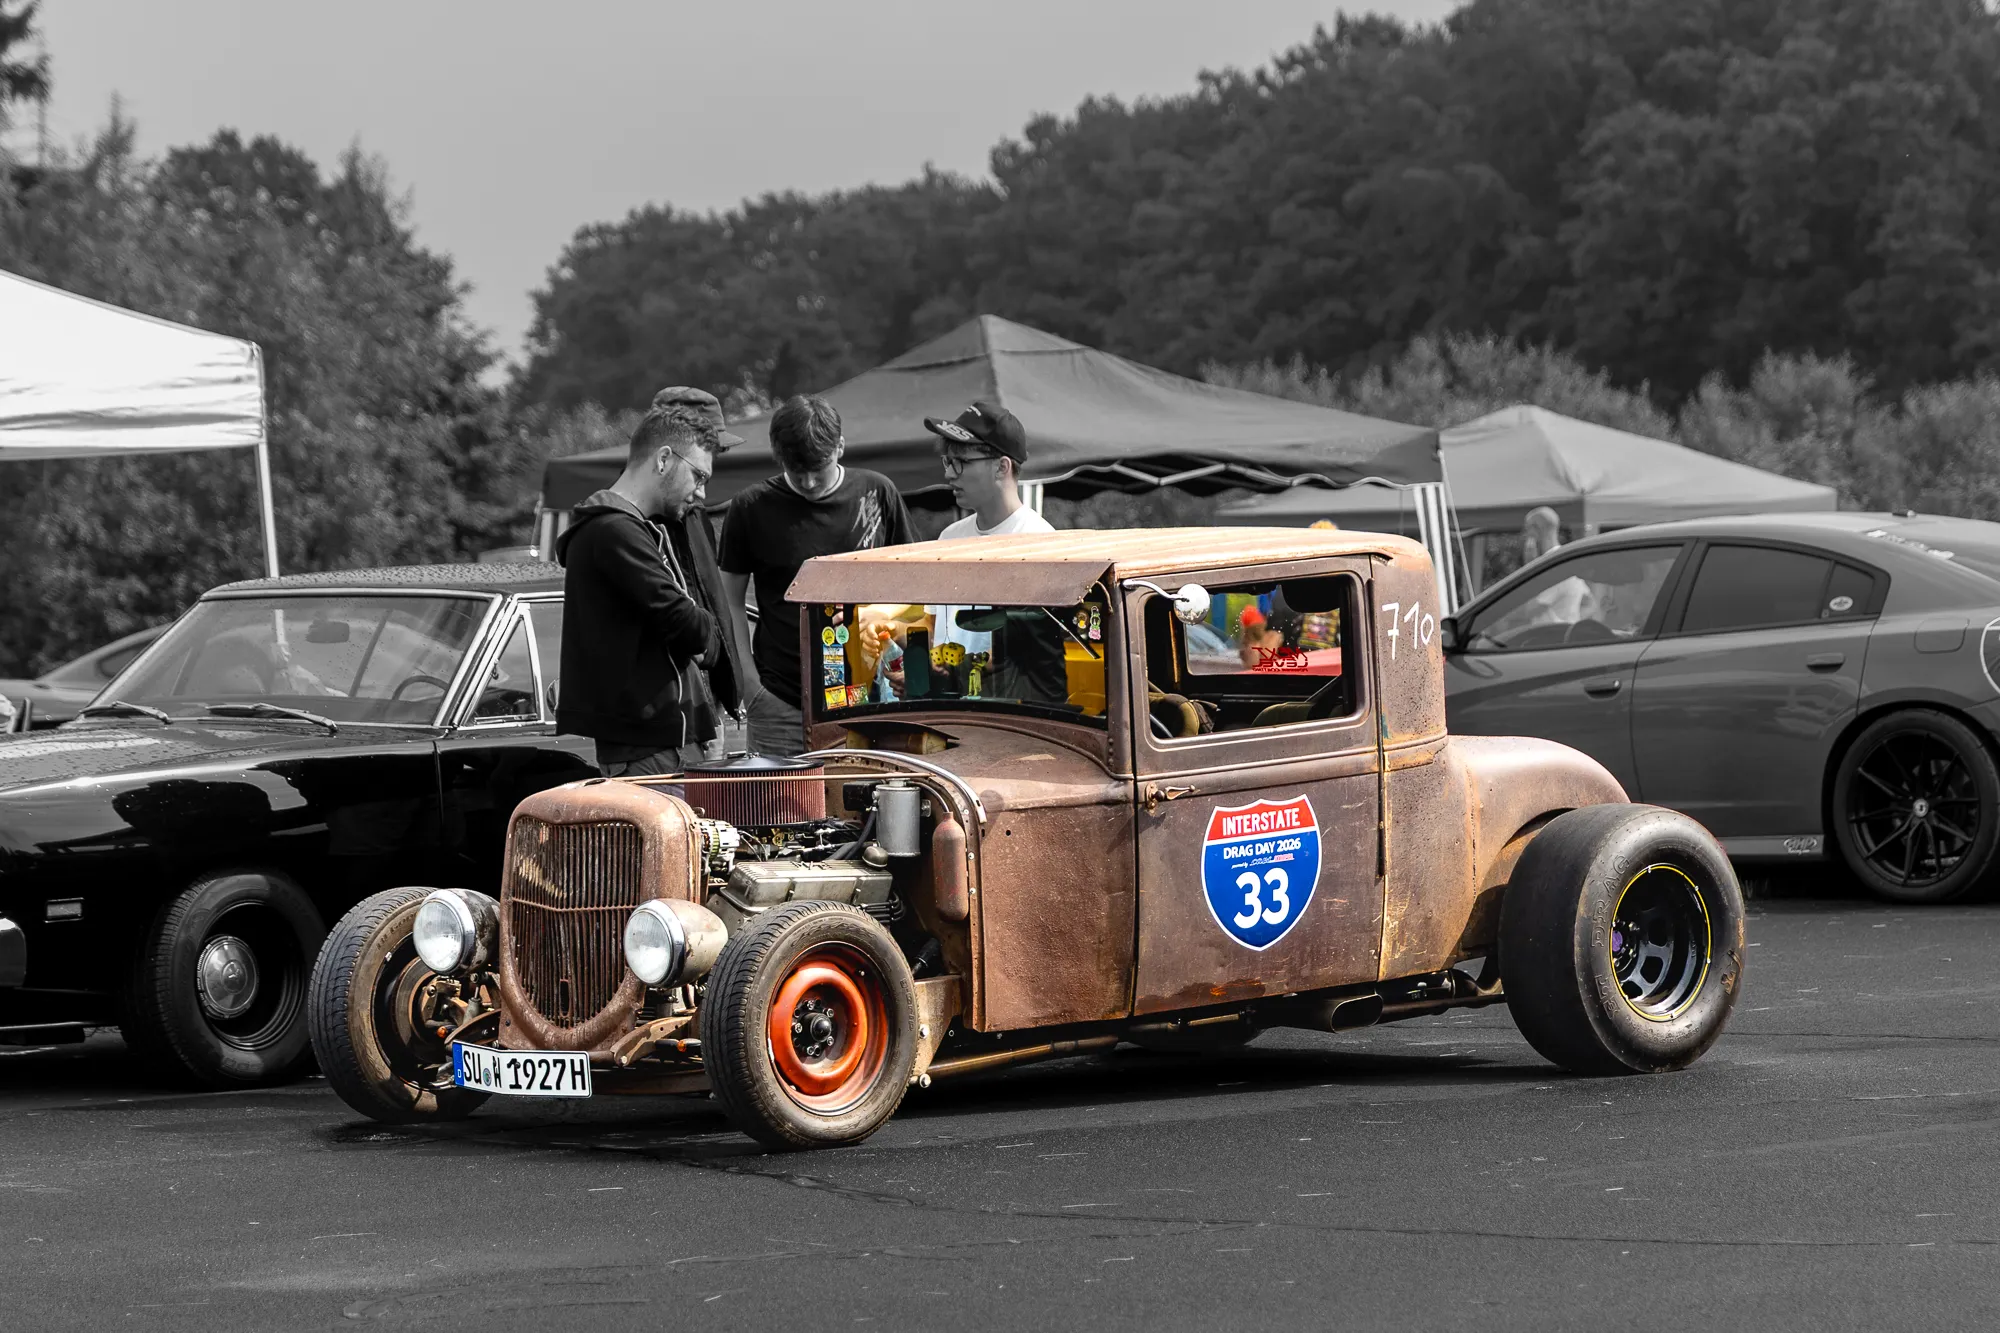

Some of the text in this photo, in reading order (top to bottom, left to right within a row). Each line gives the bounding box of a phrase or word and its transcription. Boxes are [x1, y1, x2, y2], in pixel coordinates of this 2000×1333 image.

[1382, 601, 1435, 660] 710
[1222, 807, 1301, 836] INTERSTATE
[1223, 844, 1254, 860] DRAG
[1255, 841, 1276, 855] DAY
[1277, 837, 1302, 851] 2026
[1233, 867, 1290, 929] 33
[1591, 854, 1630, 948] DRAG
[457, 1069, 462, 1078] D
[463, 1050, 482, 1085] SU
[506, 1058, 587, 1090] 1927H
